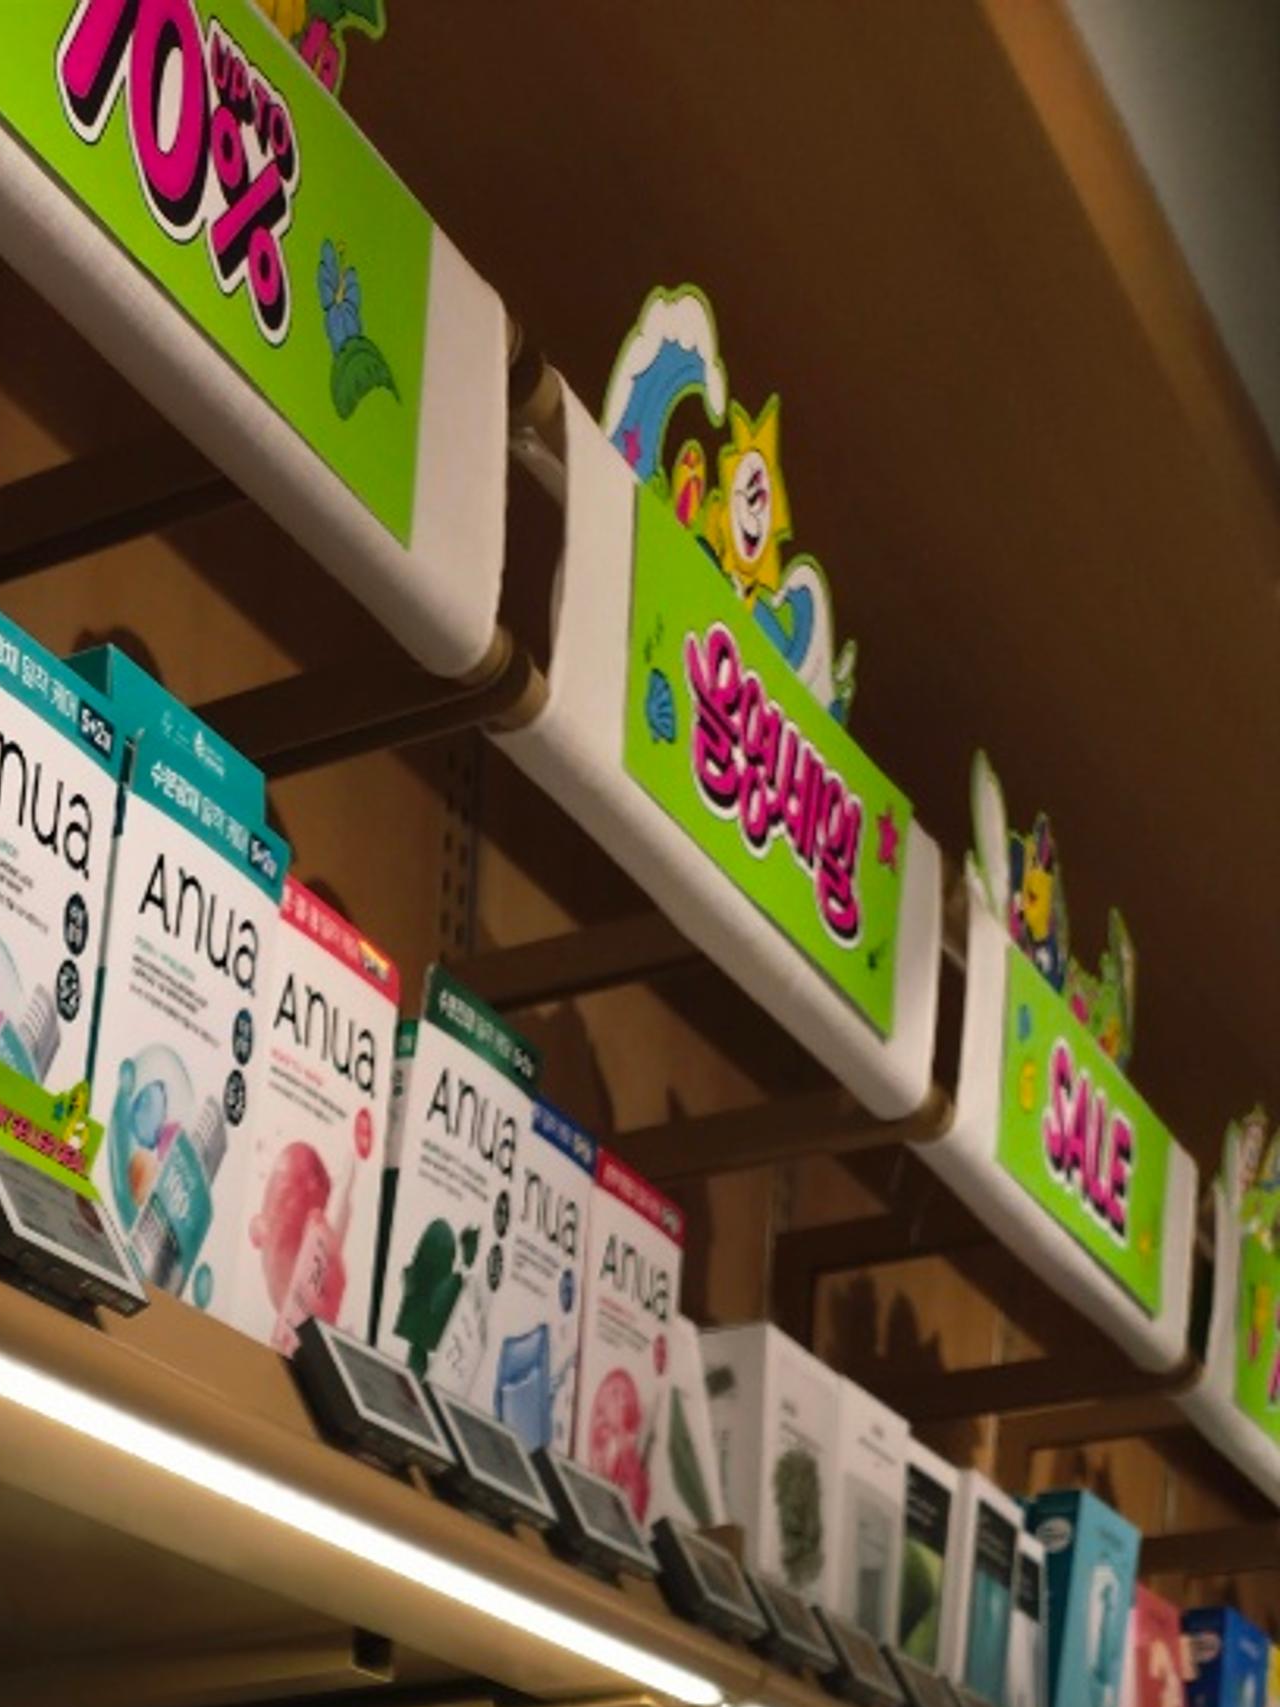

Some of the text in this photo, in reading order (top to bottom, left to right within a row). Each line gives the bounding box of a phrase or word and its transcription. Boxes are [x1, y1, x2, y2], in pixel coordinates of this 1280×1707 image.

[137, 852, 259, 998] Anua
[273, 972, 378, 1101] Anua
[426, 1067, 518, 1180] Anua
[1042, 1040, 1134, 1238] SALE
[599, 1233, 671, 1322] Anua
